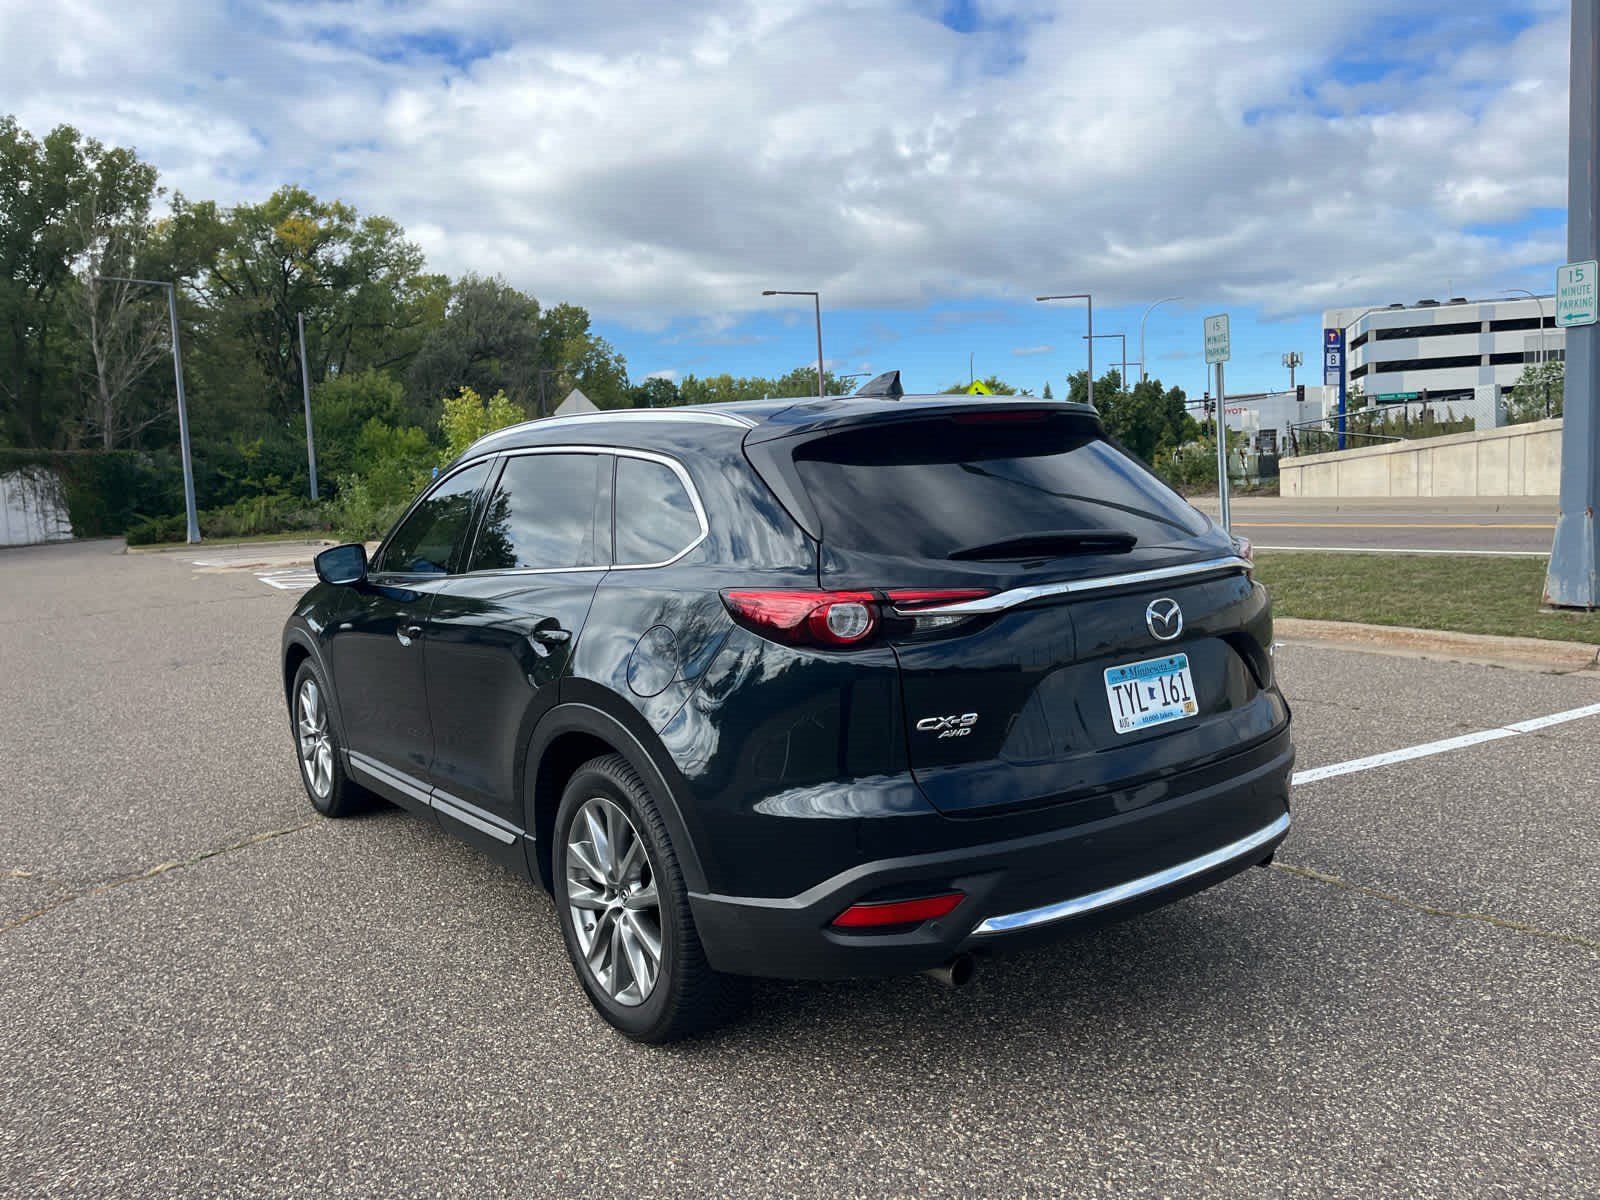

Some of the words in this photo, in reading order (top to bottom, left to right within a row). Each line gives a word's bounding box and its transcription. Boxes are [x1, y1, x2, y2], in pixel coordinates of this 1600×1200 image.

[1569, 268, 1585, 283] 15
[1561, 283, 1593, 297] MINUTE
[1560, 297, 1593, 309] PARKING
[1207, 333, 1227, 345] MINUTE
[1207, 346, 1228, 355] PARKING
[1330, 354, 1337, 365] B
[1129, 663, 1168, 678] Minnesota
[1112, 682, 1149, 717] TYL
[1158, 672, 1191, 706] 161
[916, 713, 978, 730] CX-9
[1120, 717, 1130, 728] AUG
[938, 727, 972, 739] AWD
